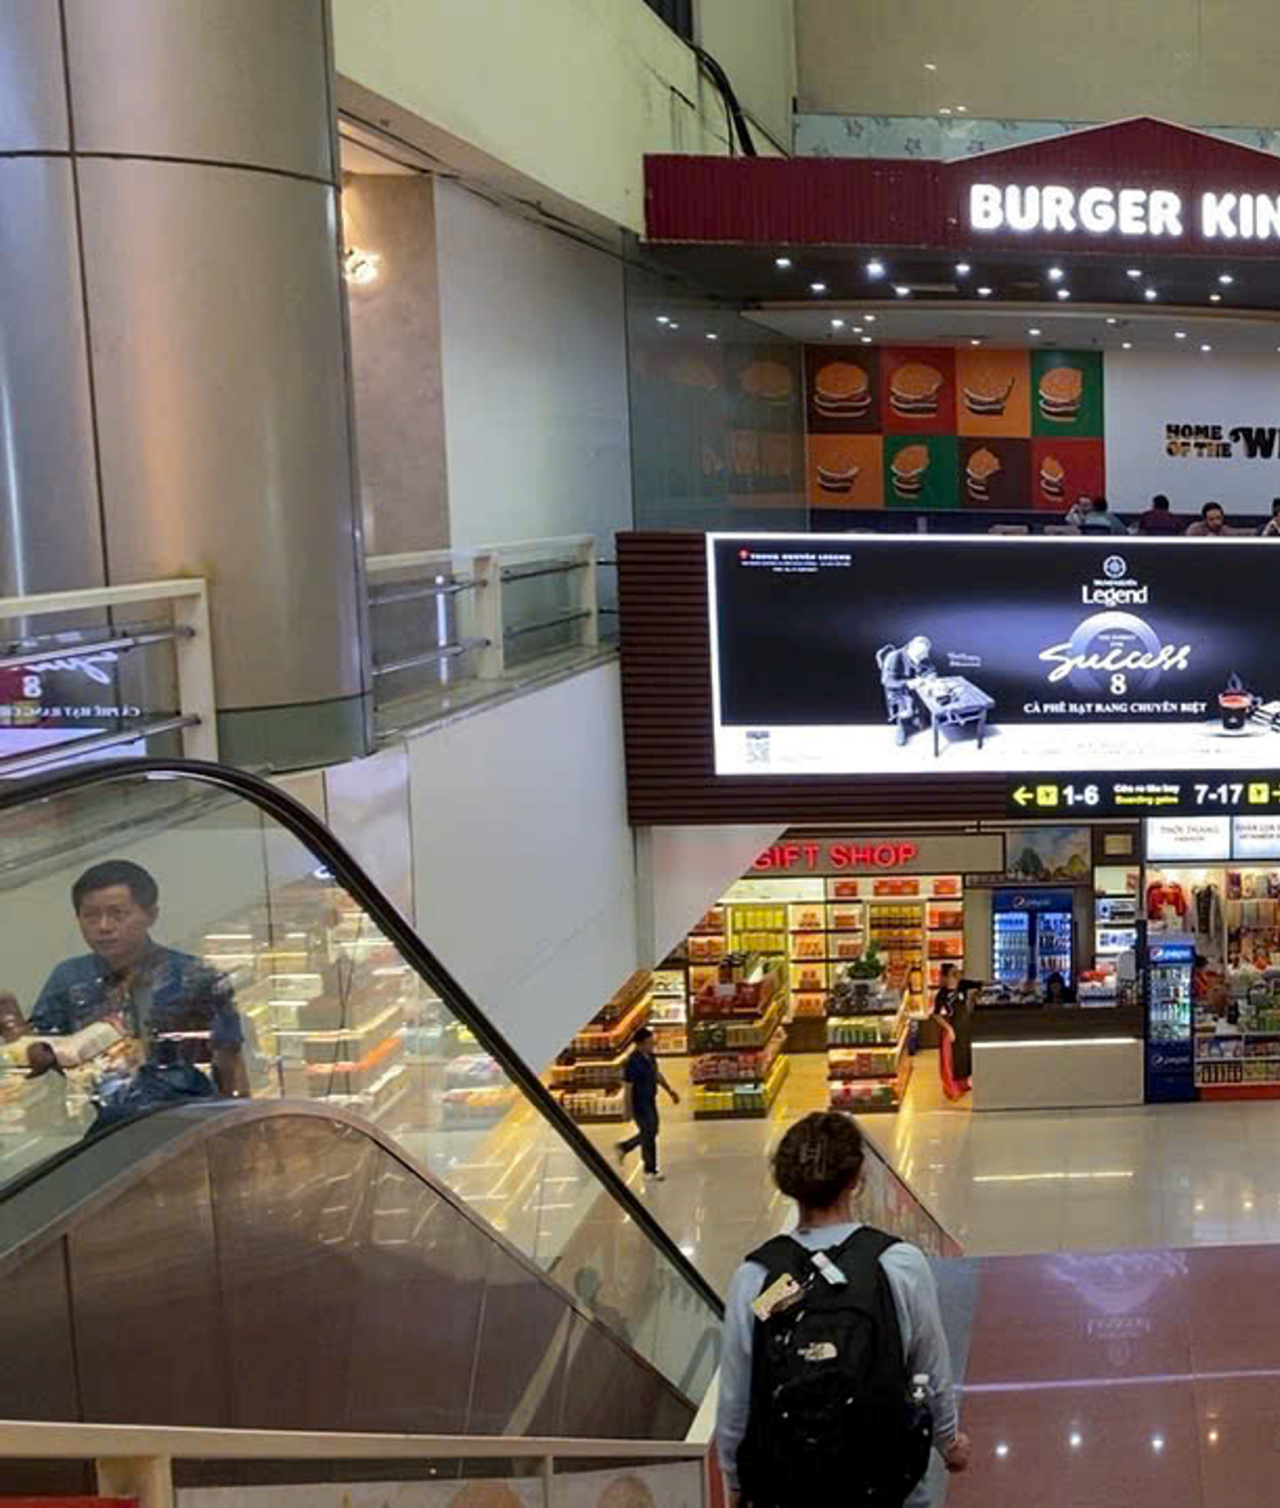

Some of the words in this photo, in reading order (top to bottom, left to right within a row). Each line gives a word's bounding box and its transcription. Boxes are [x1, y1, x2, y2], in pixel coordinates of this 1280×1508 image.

[970, 184, 1183, 236] BURGER
[1166, 424, 1222, 440] HOME
[1193, 441, 1232, 458] THE
[1082, 586, 1148, 607] Legend
[1038, 643, 1191, 682] Success
[1110, 673, 1127, 695] 8
[1023, 702, 1041, 714] CÀ
[1063, 785, 1099, 805] 1-6
[1194, 785, 1244, 805] 7-17
[753, 843, 820, 870] GIFT
[830, 842, 917, 868] SHOP
